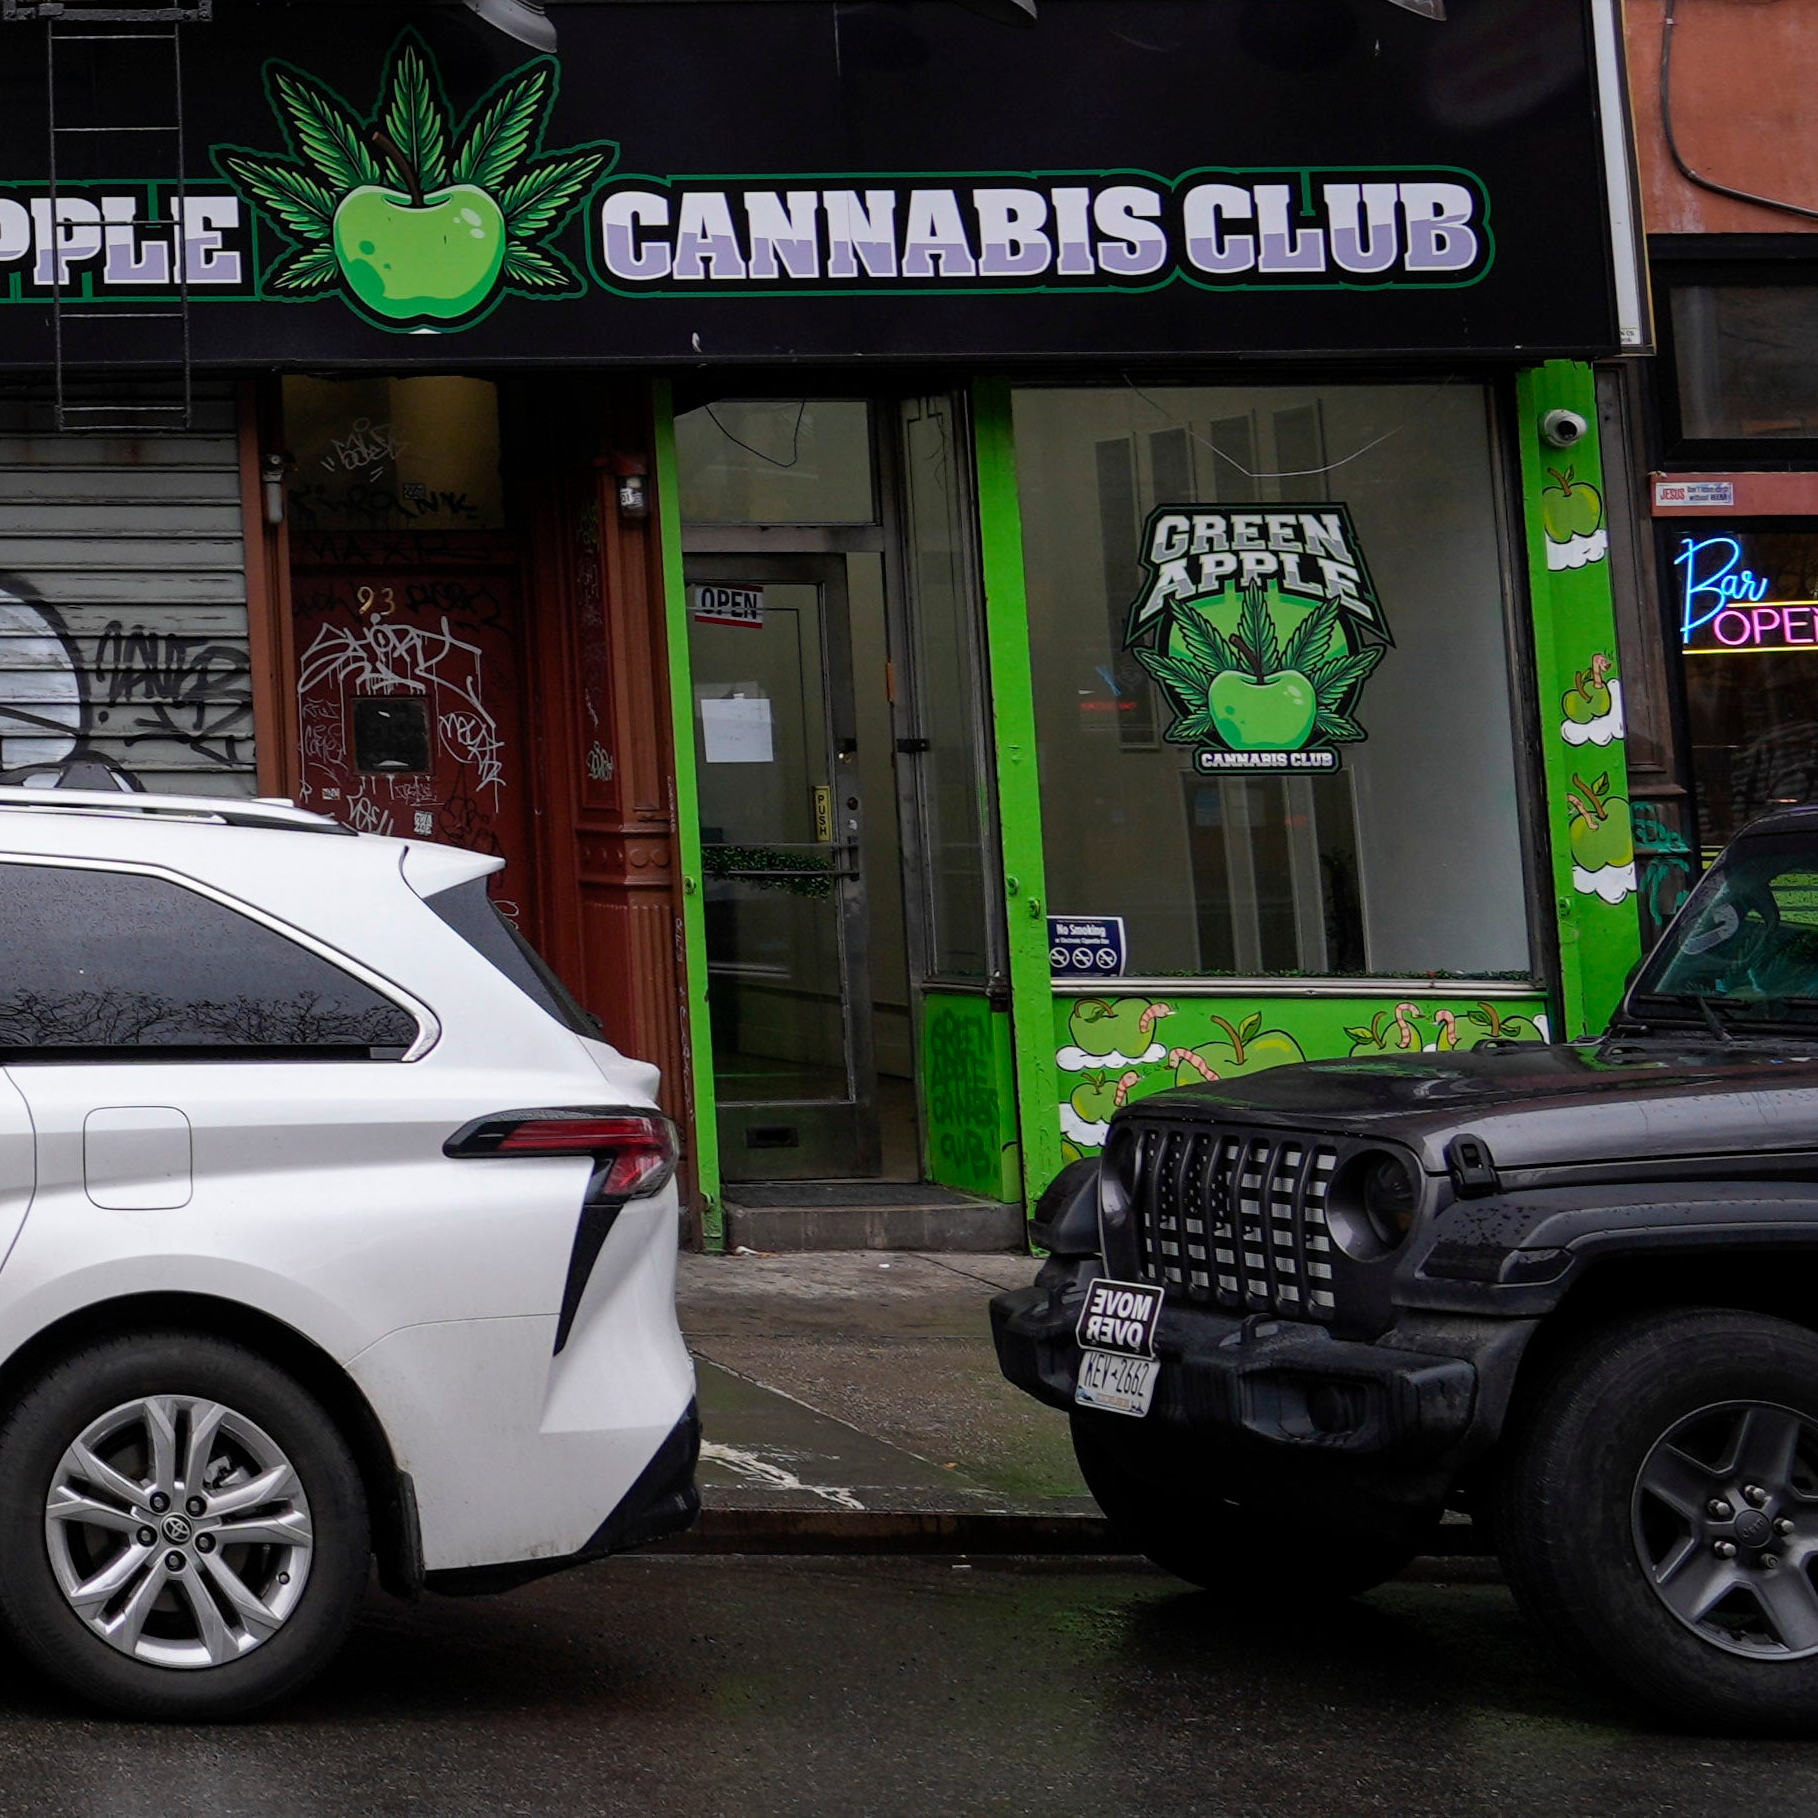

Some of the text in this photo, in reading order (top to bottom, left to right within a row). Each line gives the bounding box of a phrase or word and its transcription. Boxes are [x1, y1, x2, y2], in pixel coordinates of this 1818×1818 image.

[601, 180, 1480, 282] CANNABIS CLUB
[1150, 514, 1356, 566] GREEN
[356, 585, 397, 616] 93
[700, 586, 759, 621] OPEN
[1138, 550, 1376, 623] APPLE
[1674, 536, 1768, 644] Bar
[1712, 606, 1818, 646] OPE
[1200, 752, 1333, 768] CANNABIS CLUB
[816, 794, 828, 838] PUSH
[1056, 923, 1107, 938] No Smoking
[1116, 1358, 1151, 1397] 2662
